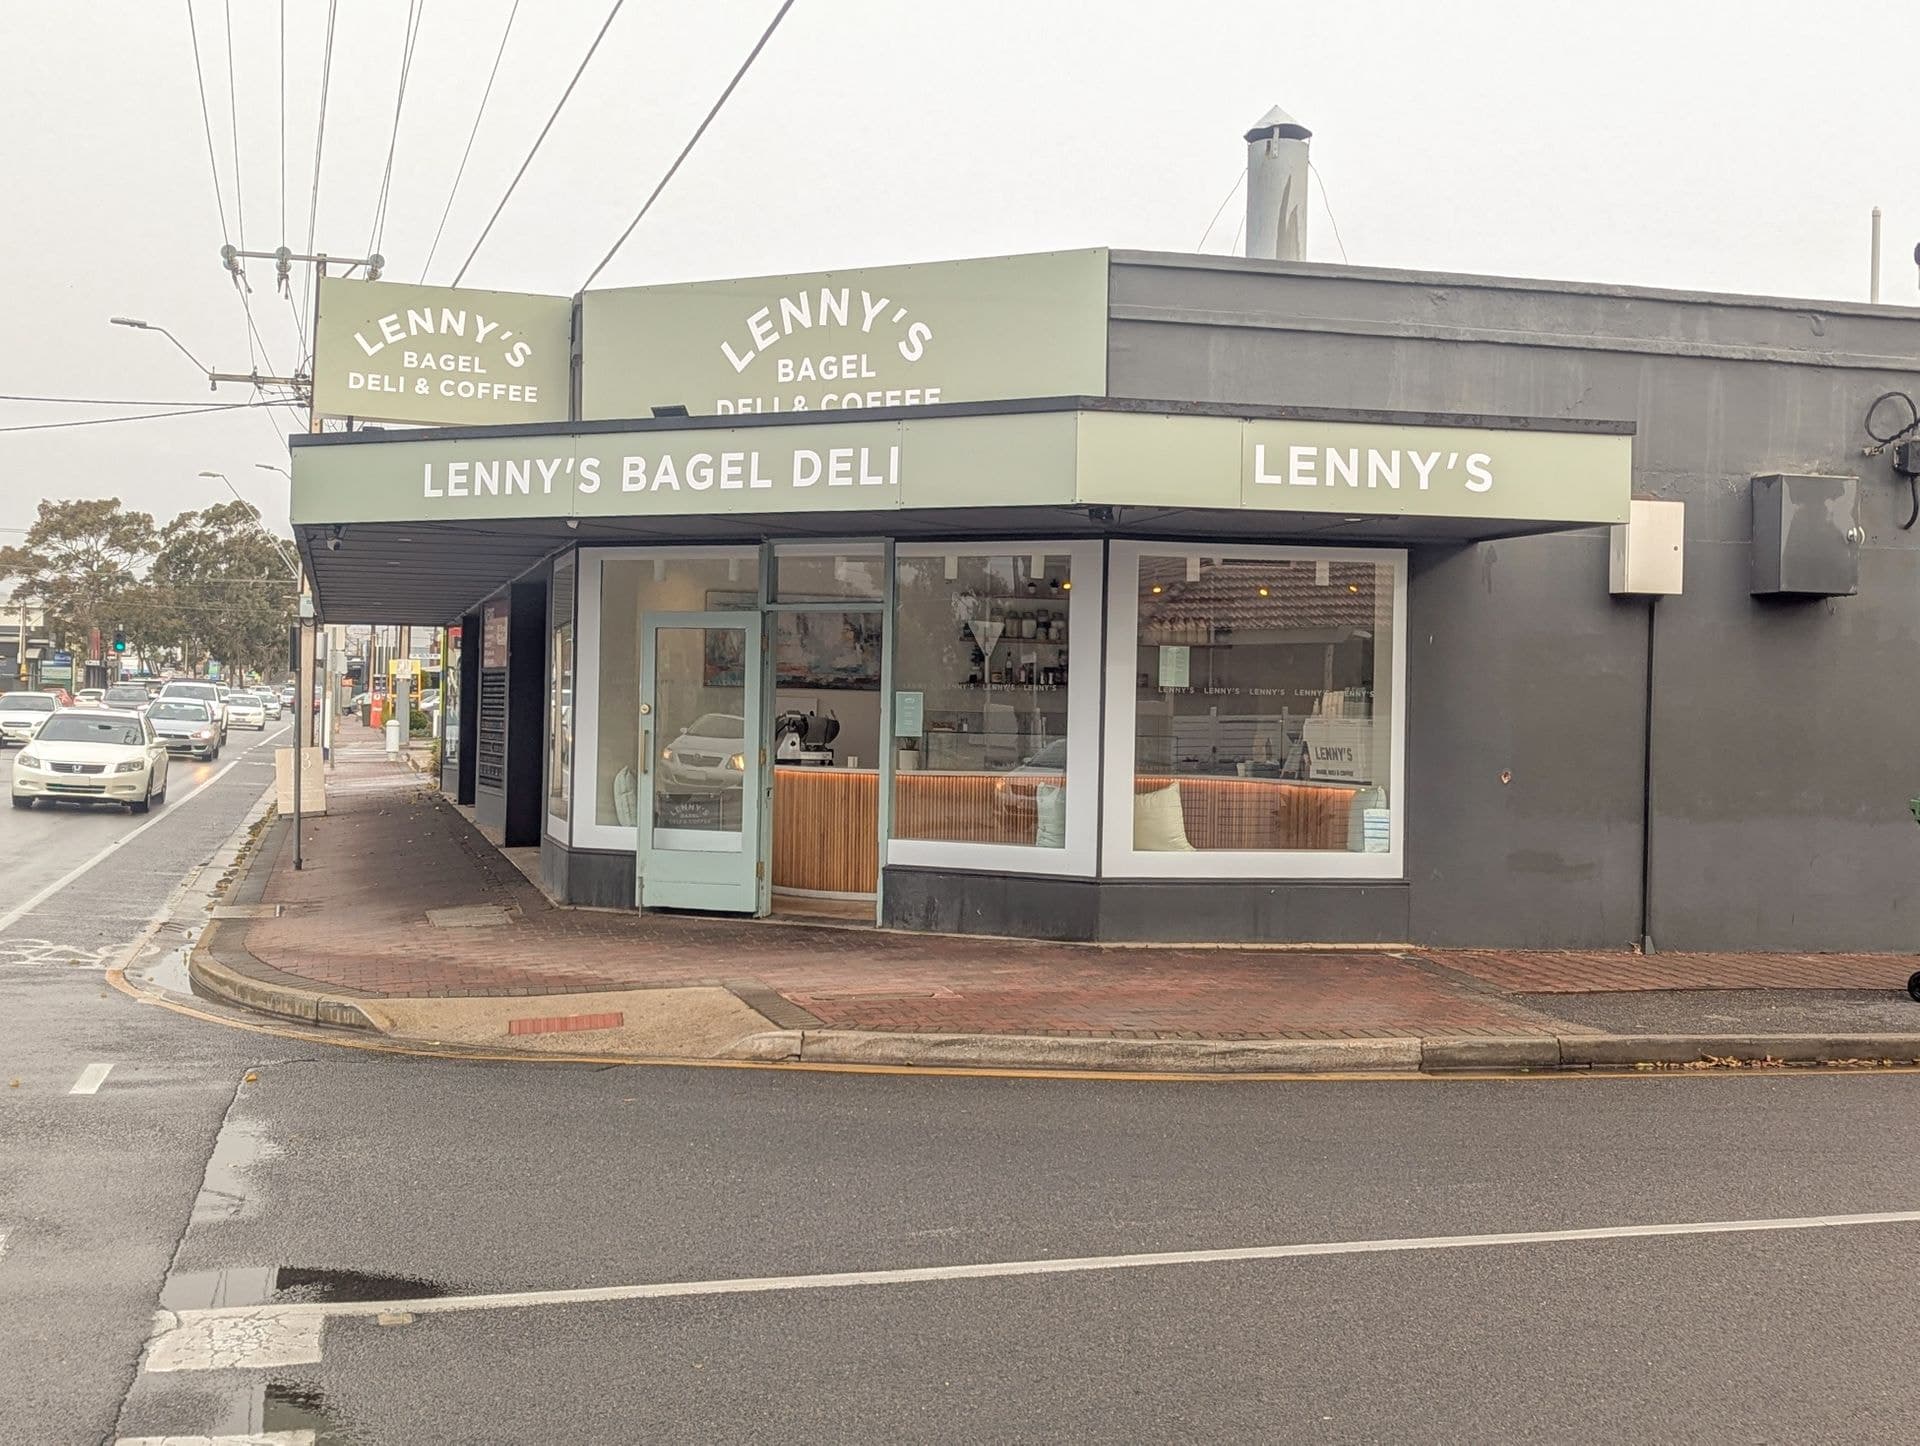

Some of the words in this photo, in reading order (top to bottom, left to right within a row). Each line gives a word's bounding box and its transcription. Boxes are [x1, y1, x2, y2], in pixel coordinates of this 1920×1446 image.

[353, 307, 532, 368] LENNY'S
[720, 287, 933, 374] LENNY'S
[403, 351, 487, 374] BAGEL
[777, 353, 877, 383] BAGEL
[348, 371, 405, 393] DELI
[414, 377, 430, 395] &
[439, 379, 538, 403] COFFEE
[423, 457, 601, 498] LENNY'S
[621, 451, 773, 492] BAGEL
[792, 445, 899, 488] DELI
[1254, 443, 1494, 493] LENNY'S
[1203, 687, 1241, 695] LENNY'S
[1248, 688, 1286, 696] LENNY'S
[1315, 746, 1353, 762] LENNY'S
